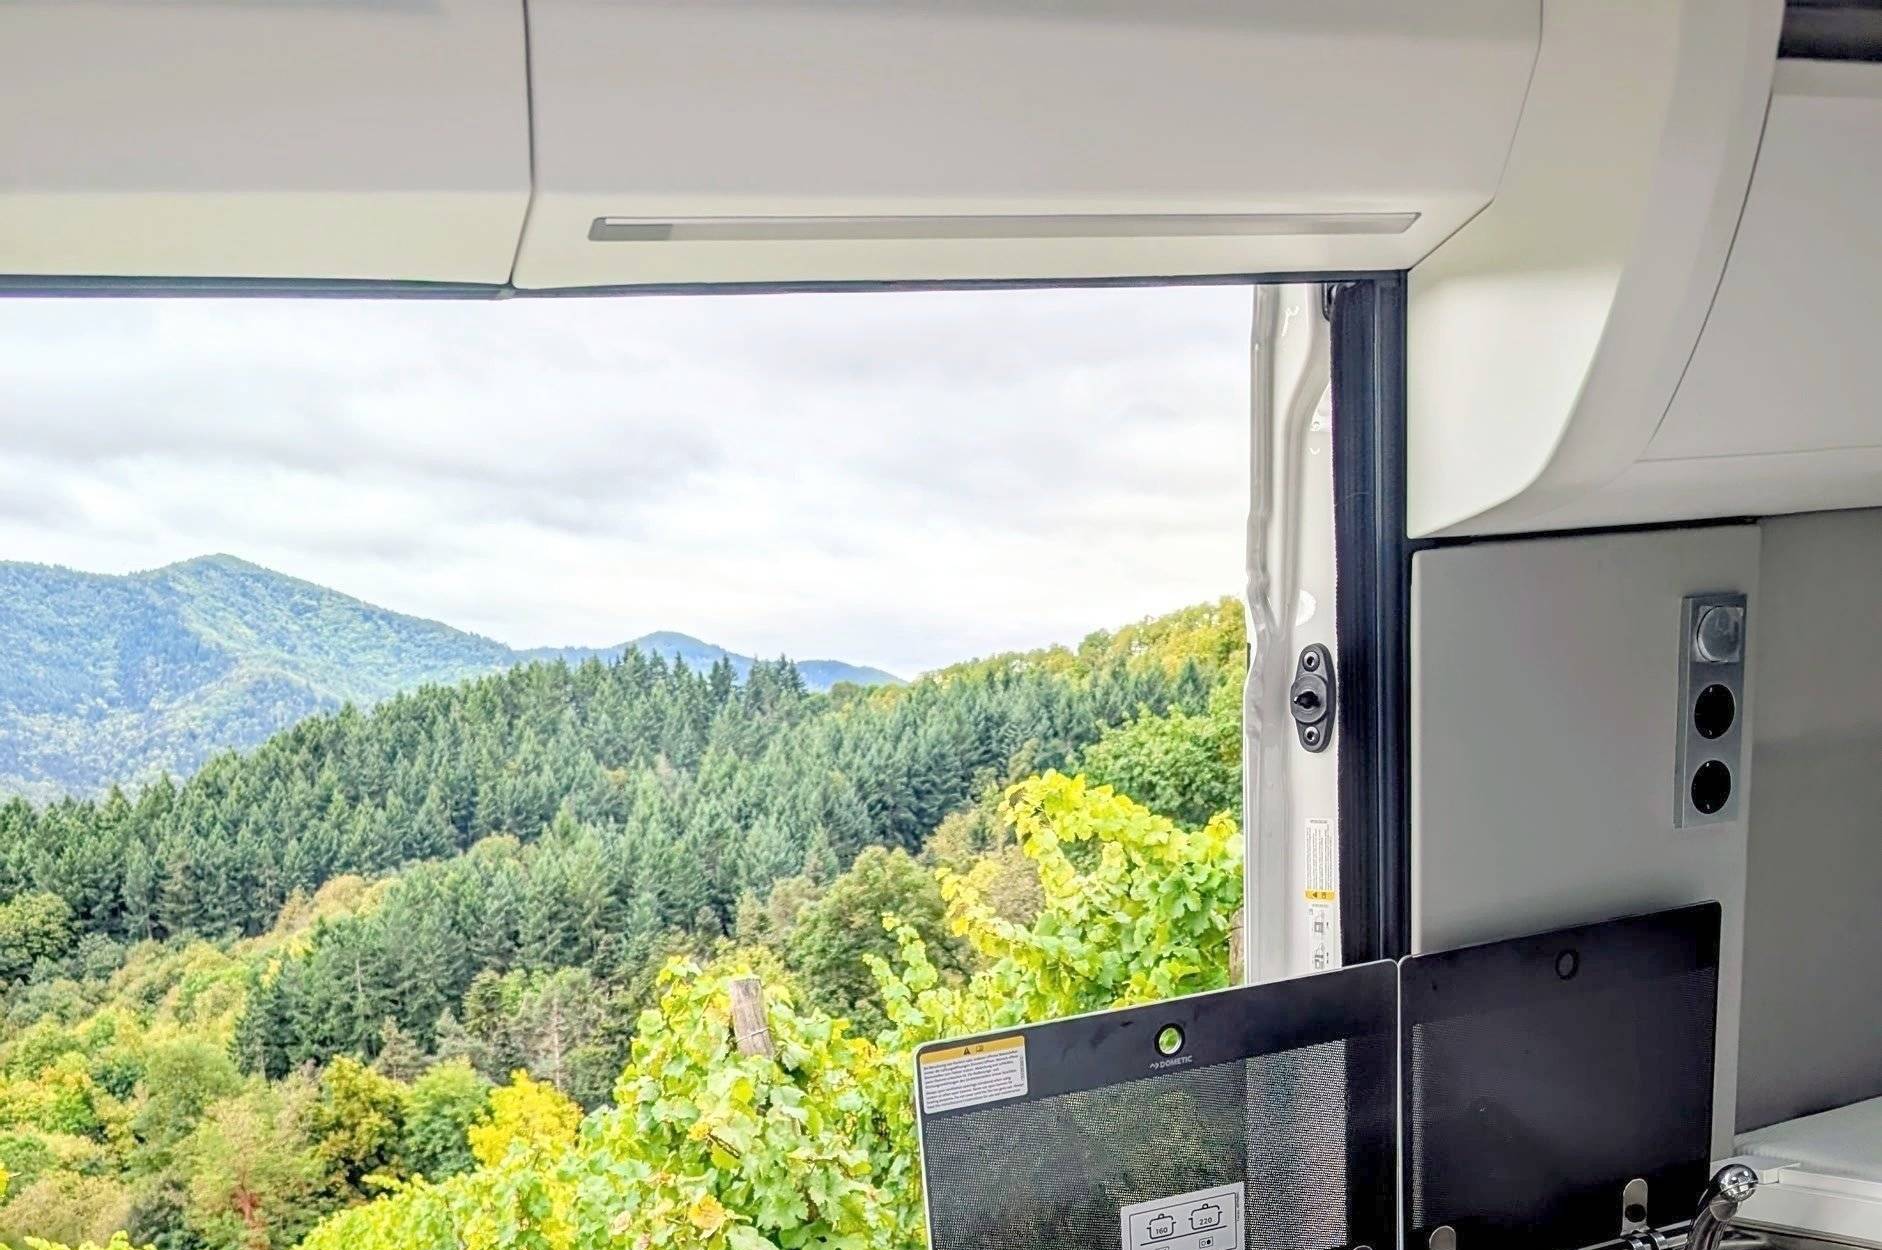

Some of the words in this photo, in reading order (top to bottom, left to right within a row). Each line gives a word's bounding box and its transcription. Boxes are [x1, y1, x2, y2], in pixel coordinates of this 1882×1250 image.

[1160, 1055, 1192, 1068] DOMETIC
[1200, 1217, 1213, 1225] 220
[1156, 1227, 1168, 1235] 160
